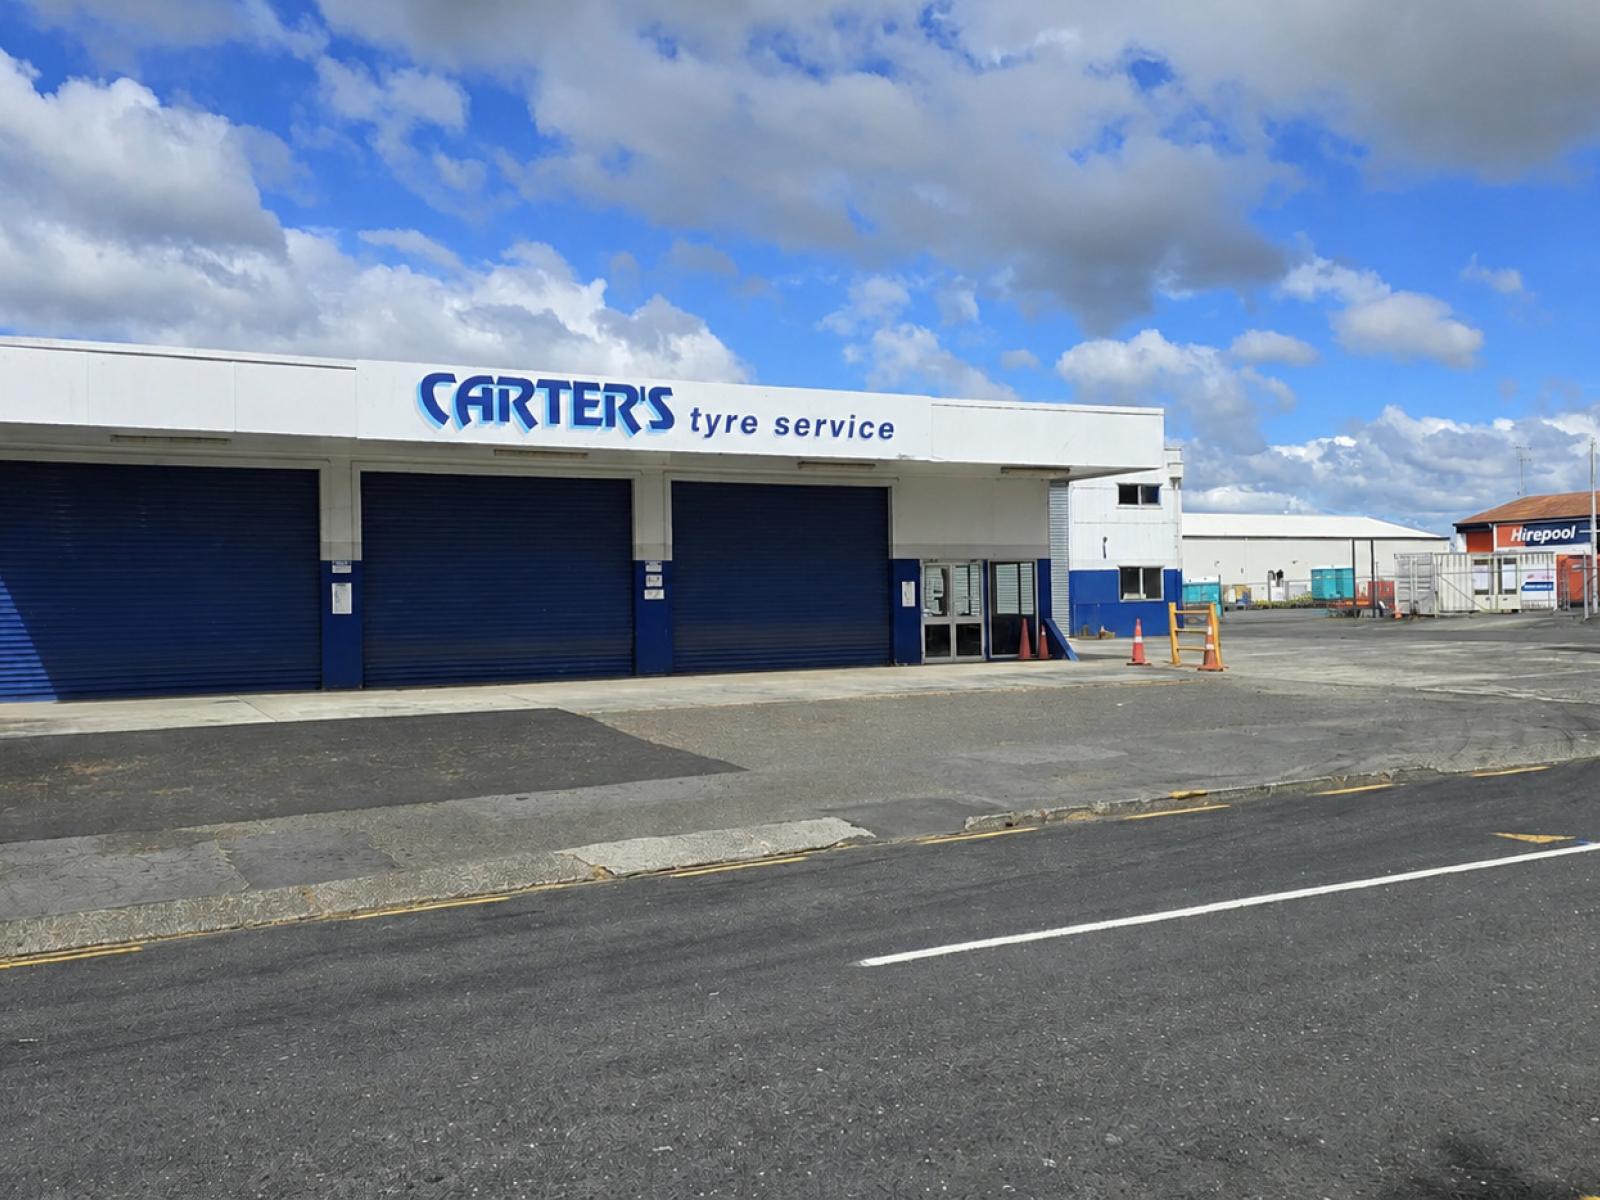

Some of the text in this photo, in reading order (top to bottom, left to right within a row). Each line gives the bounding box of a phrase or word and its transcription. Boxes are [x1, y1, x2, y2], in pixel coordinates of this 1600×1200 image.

[418, 372, 896, 440] CARTER'S tyre service
[1511, 525, 1576, 544] Hirepool
